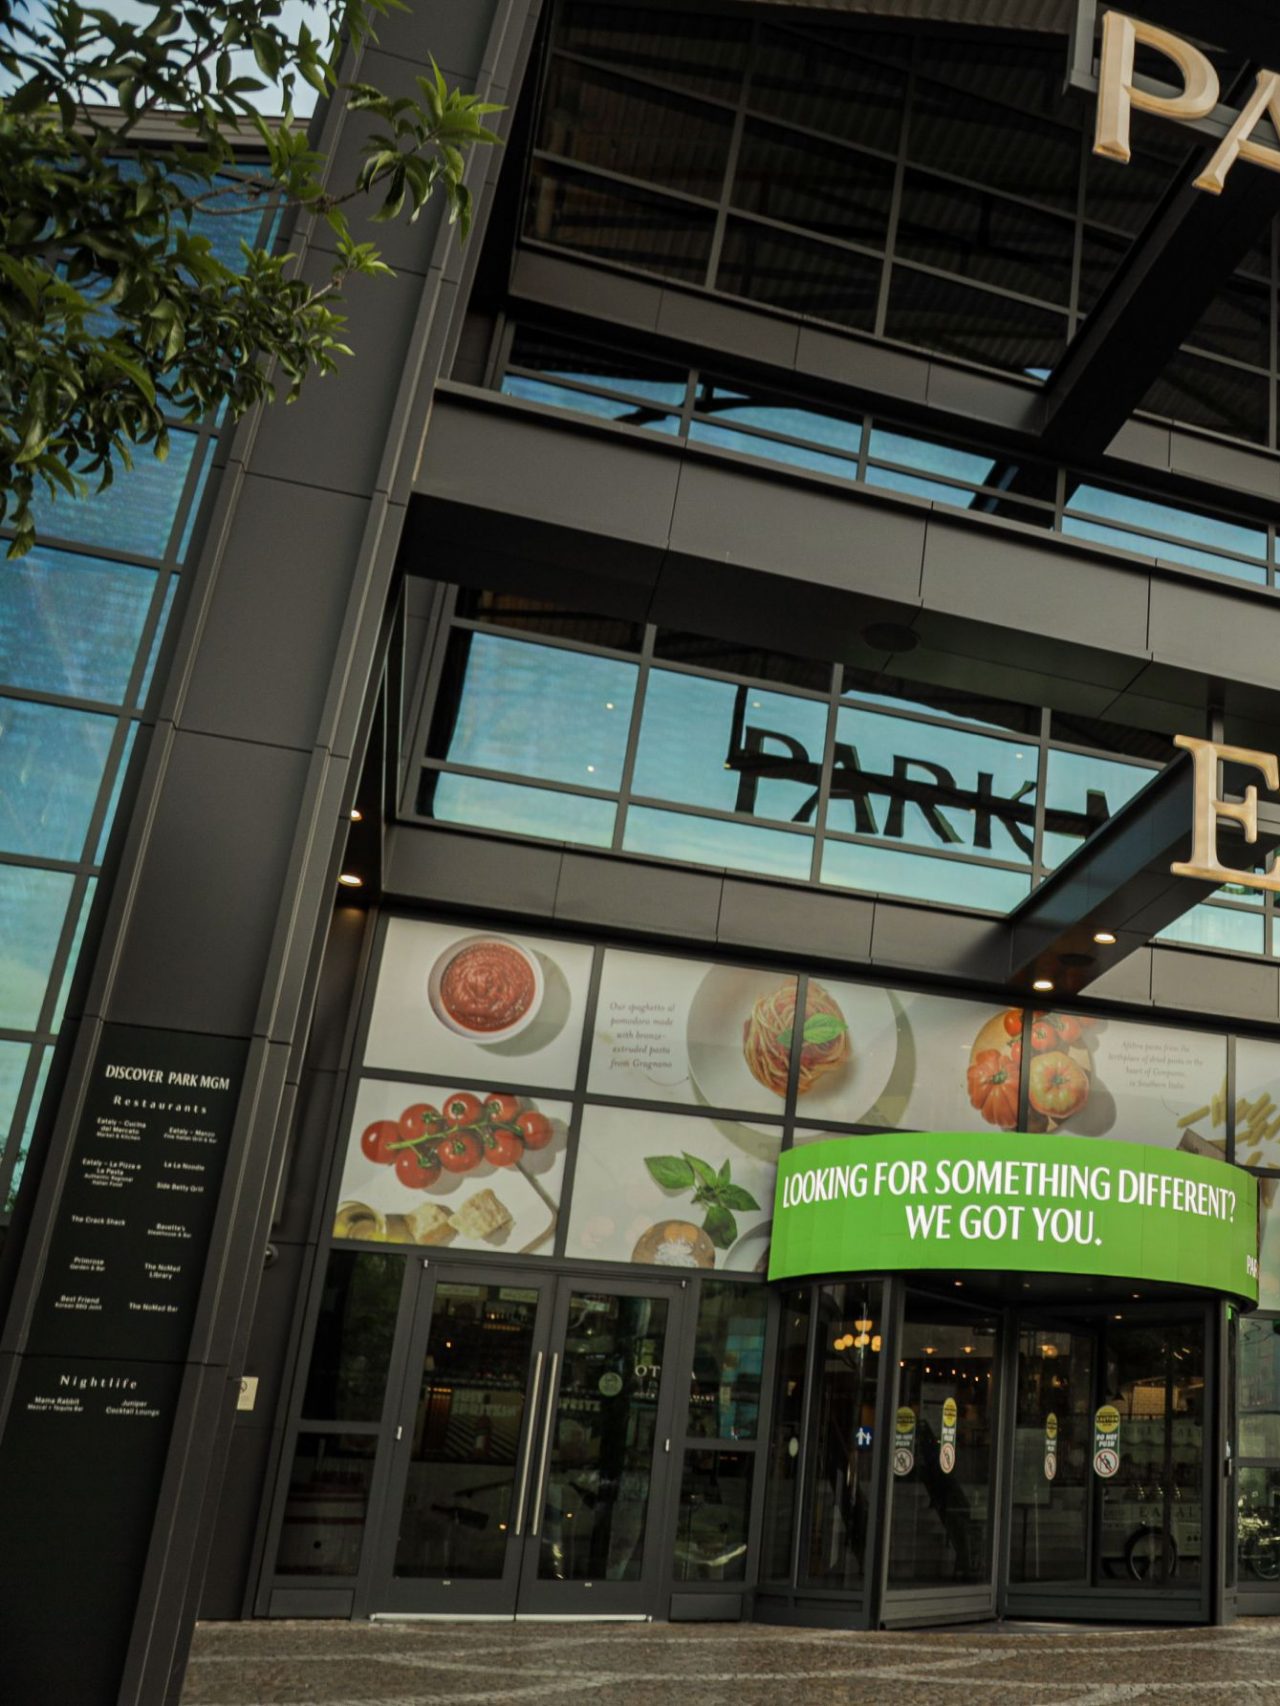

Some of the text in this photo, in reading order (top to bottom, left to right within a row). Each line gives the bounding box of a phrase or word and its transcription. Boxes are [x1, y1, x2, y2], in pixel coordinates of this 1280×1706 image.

[105, 1064, 230, 1090] DISCOVER PARK MGM
[113, 1095, 207, 1114] Restaurants
[783, 1159, 1236, 1223] LOOKING FOR SOMETHING DIFFERENT?
[72, 1215, 84, 1223] The
[905, 1204, 1102, 1246] WE GOT YOU.
[60, 1374, 137, 1390] Nightlife
